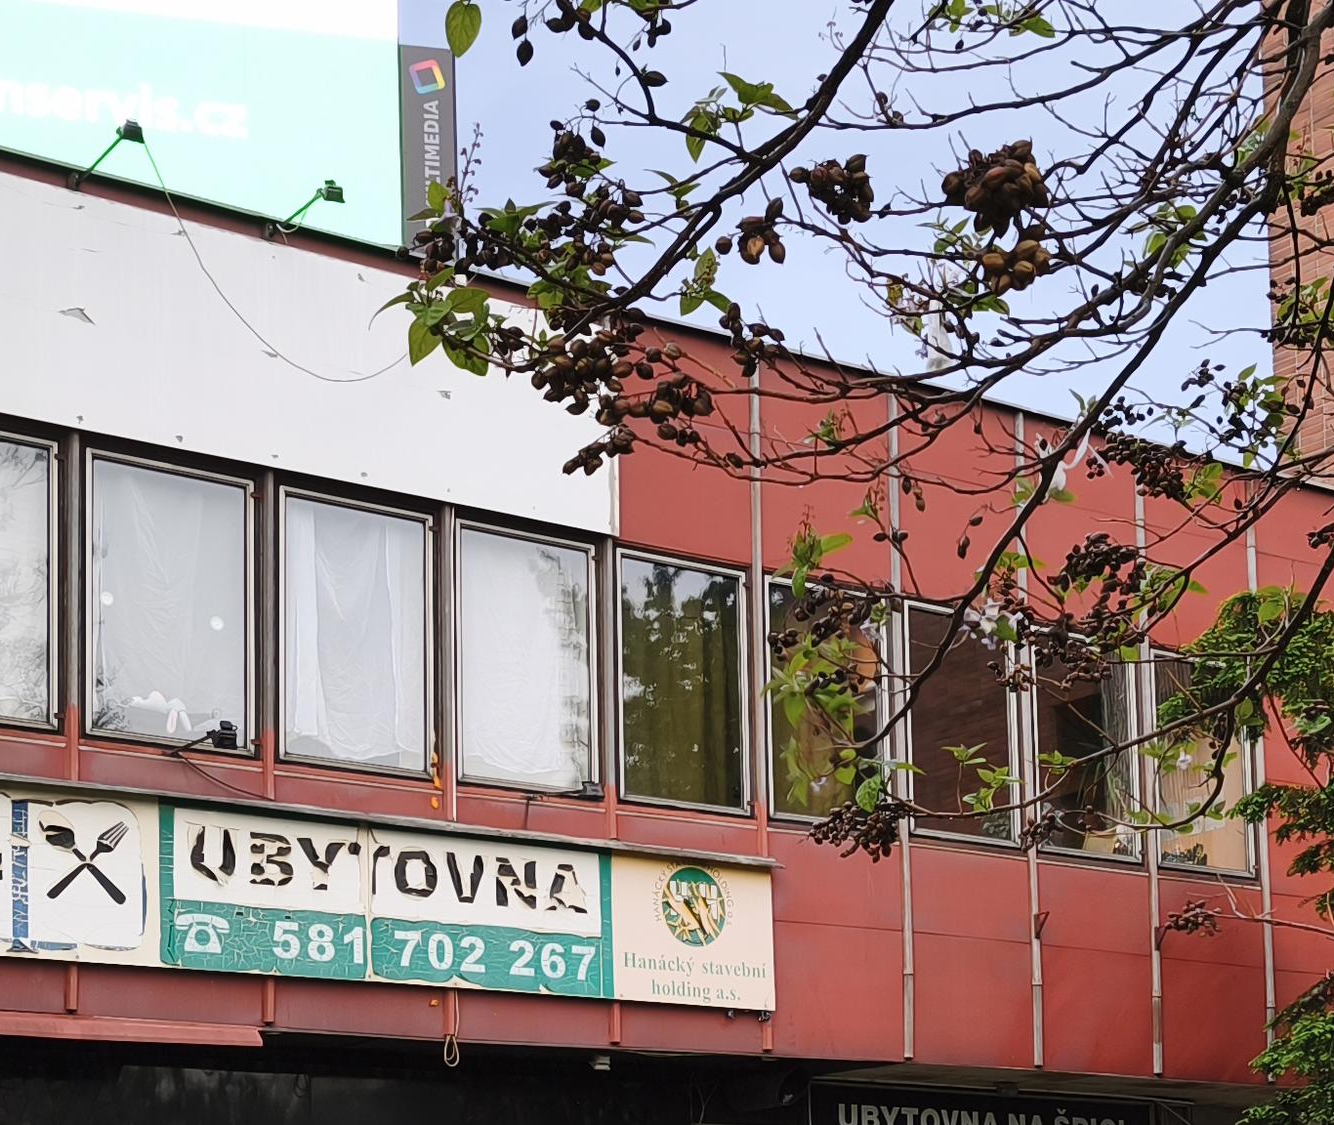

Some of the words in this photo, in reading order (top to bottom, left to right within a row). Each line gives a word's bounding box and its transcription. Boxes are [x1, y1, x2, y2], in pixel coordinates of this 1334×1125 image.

[187, 824, 589, 914] UBYTOVNA
[272, 921, 364, 965] 581
[394, 930, 486, 974] 702
[509, 940, 597, 982] 267
[624, 951, 695, 977] Hanácký
[702, 961, 767, 979] stavební
[651, 979, 712, 1003] holding
[716, 985, 742, 1001] a.s.
